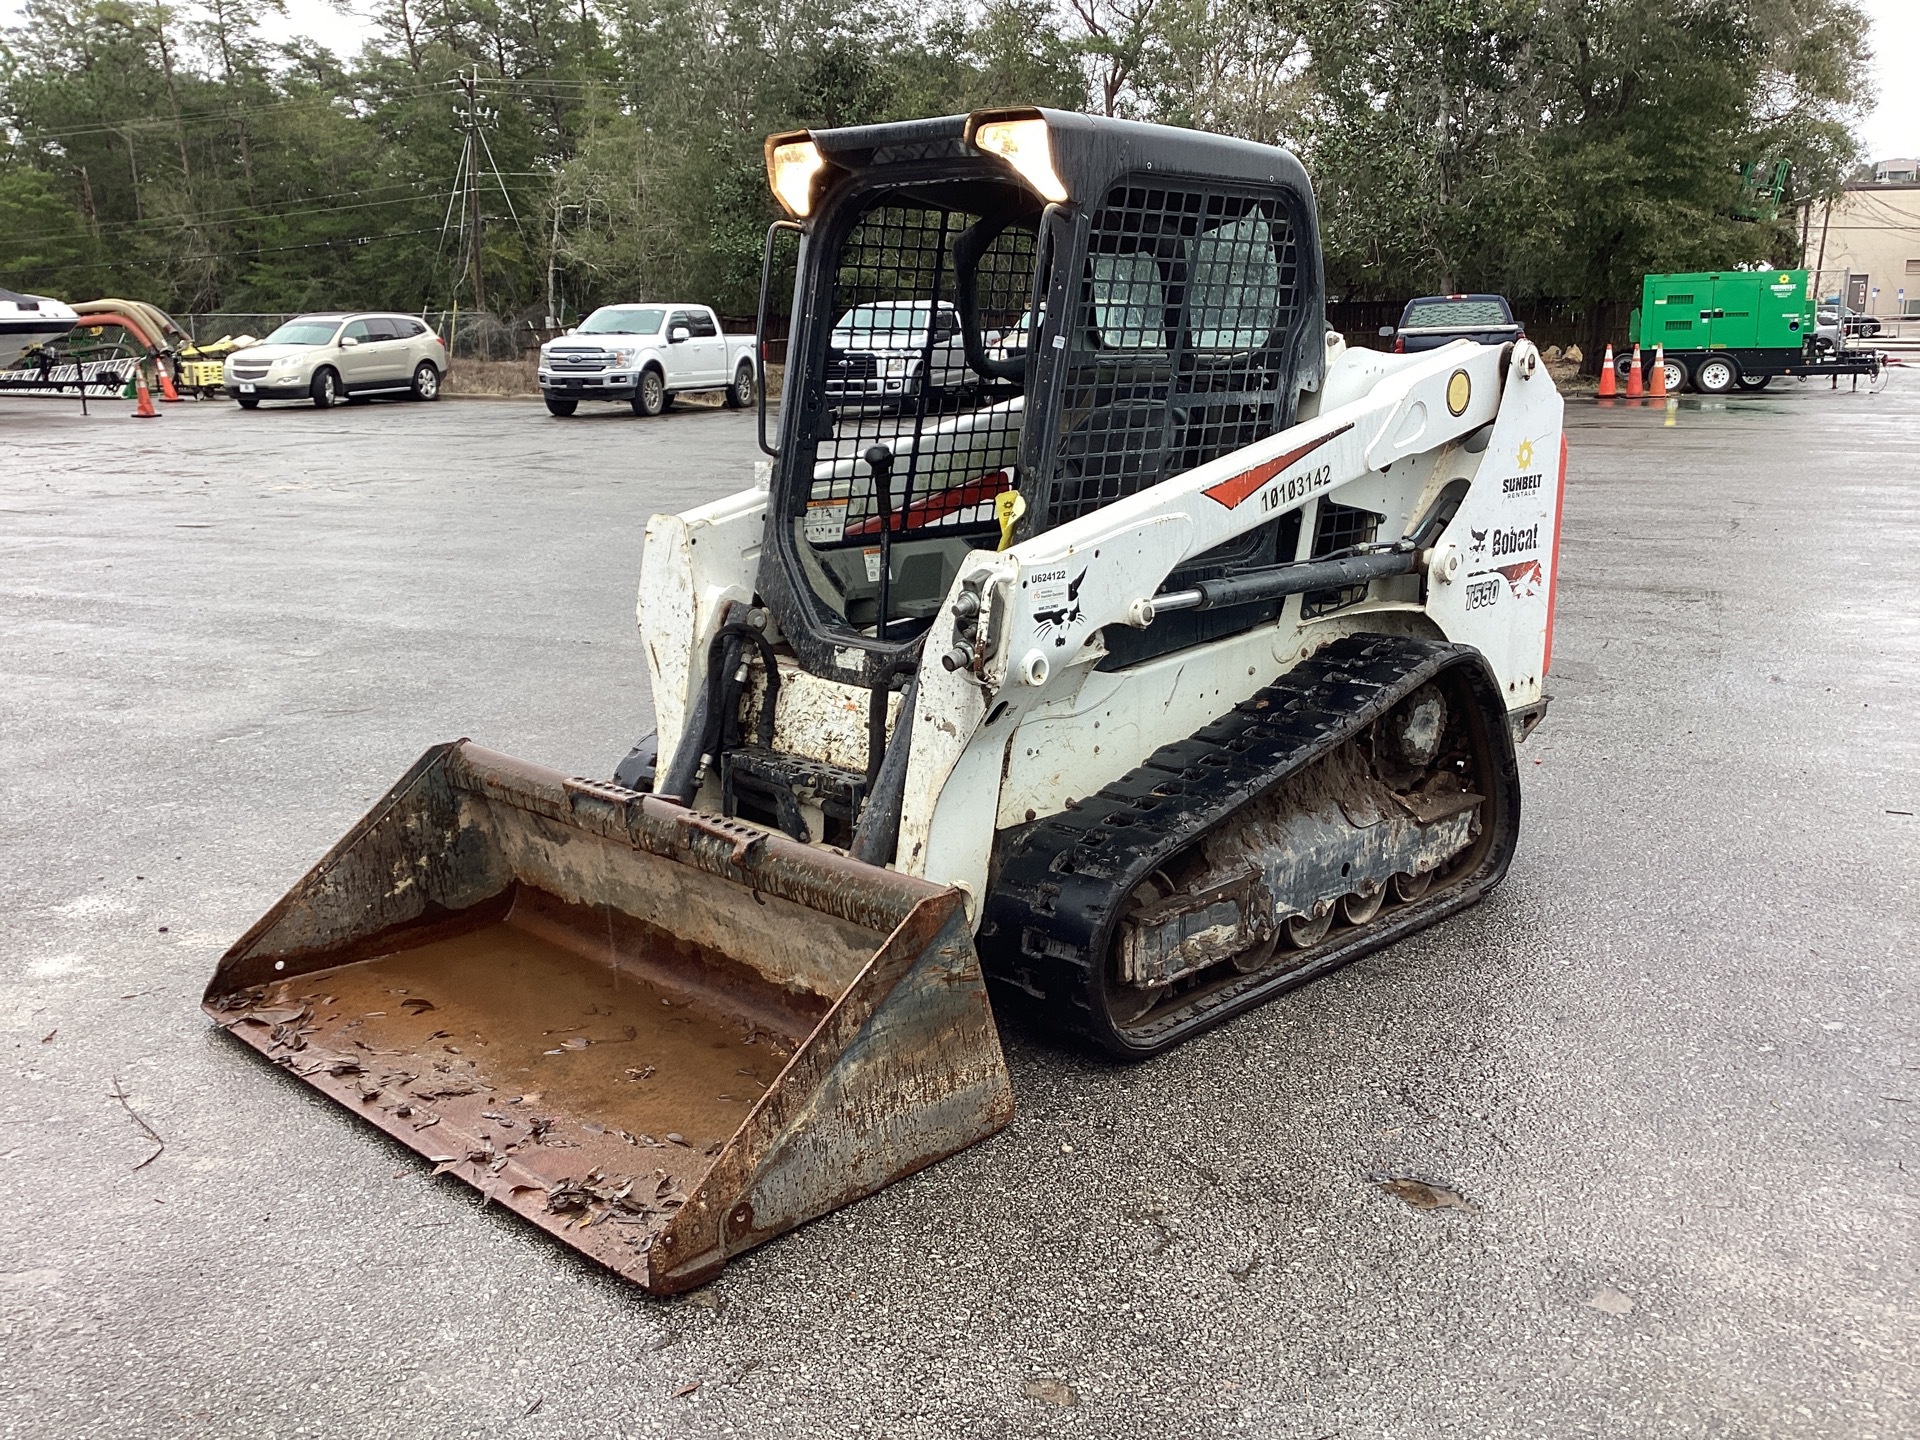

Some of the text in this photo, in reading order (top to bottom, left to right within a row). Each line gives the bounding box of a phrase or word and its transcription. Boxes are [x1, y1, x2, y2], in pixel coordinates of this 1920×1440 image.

[1261, 464, 1331, 512] 10103142
[1502, 473, 1543, 494] SUNBELT
[1507, 489, 1536, 500] RENTALS
[1492, 523, 1538, 558] Bobcat
[1031, 570, 1066, 584] U624122
[1465, 578, 1500, 611] T550
